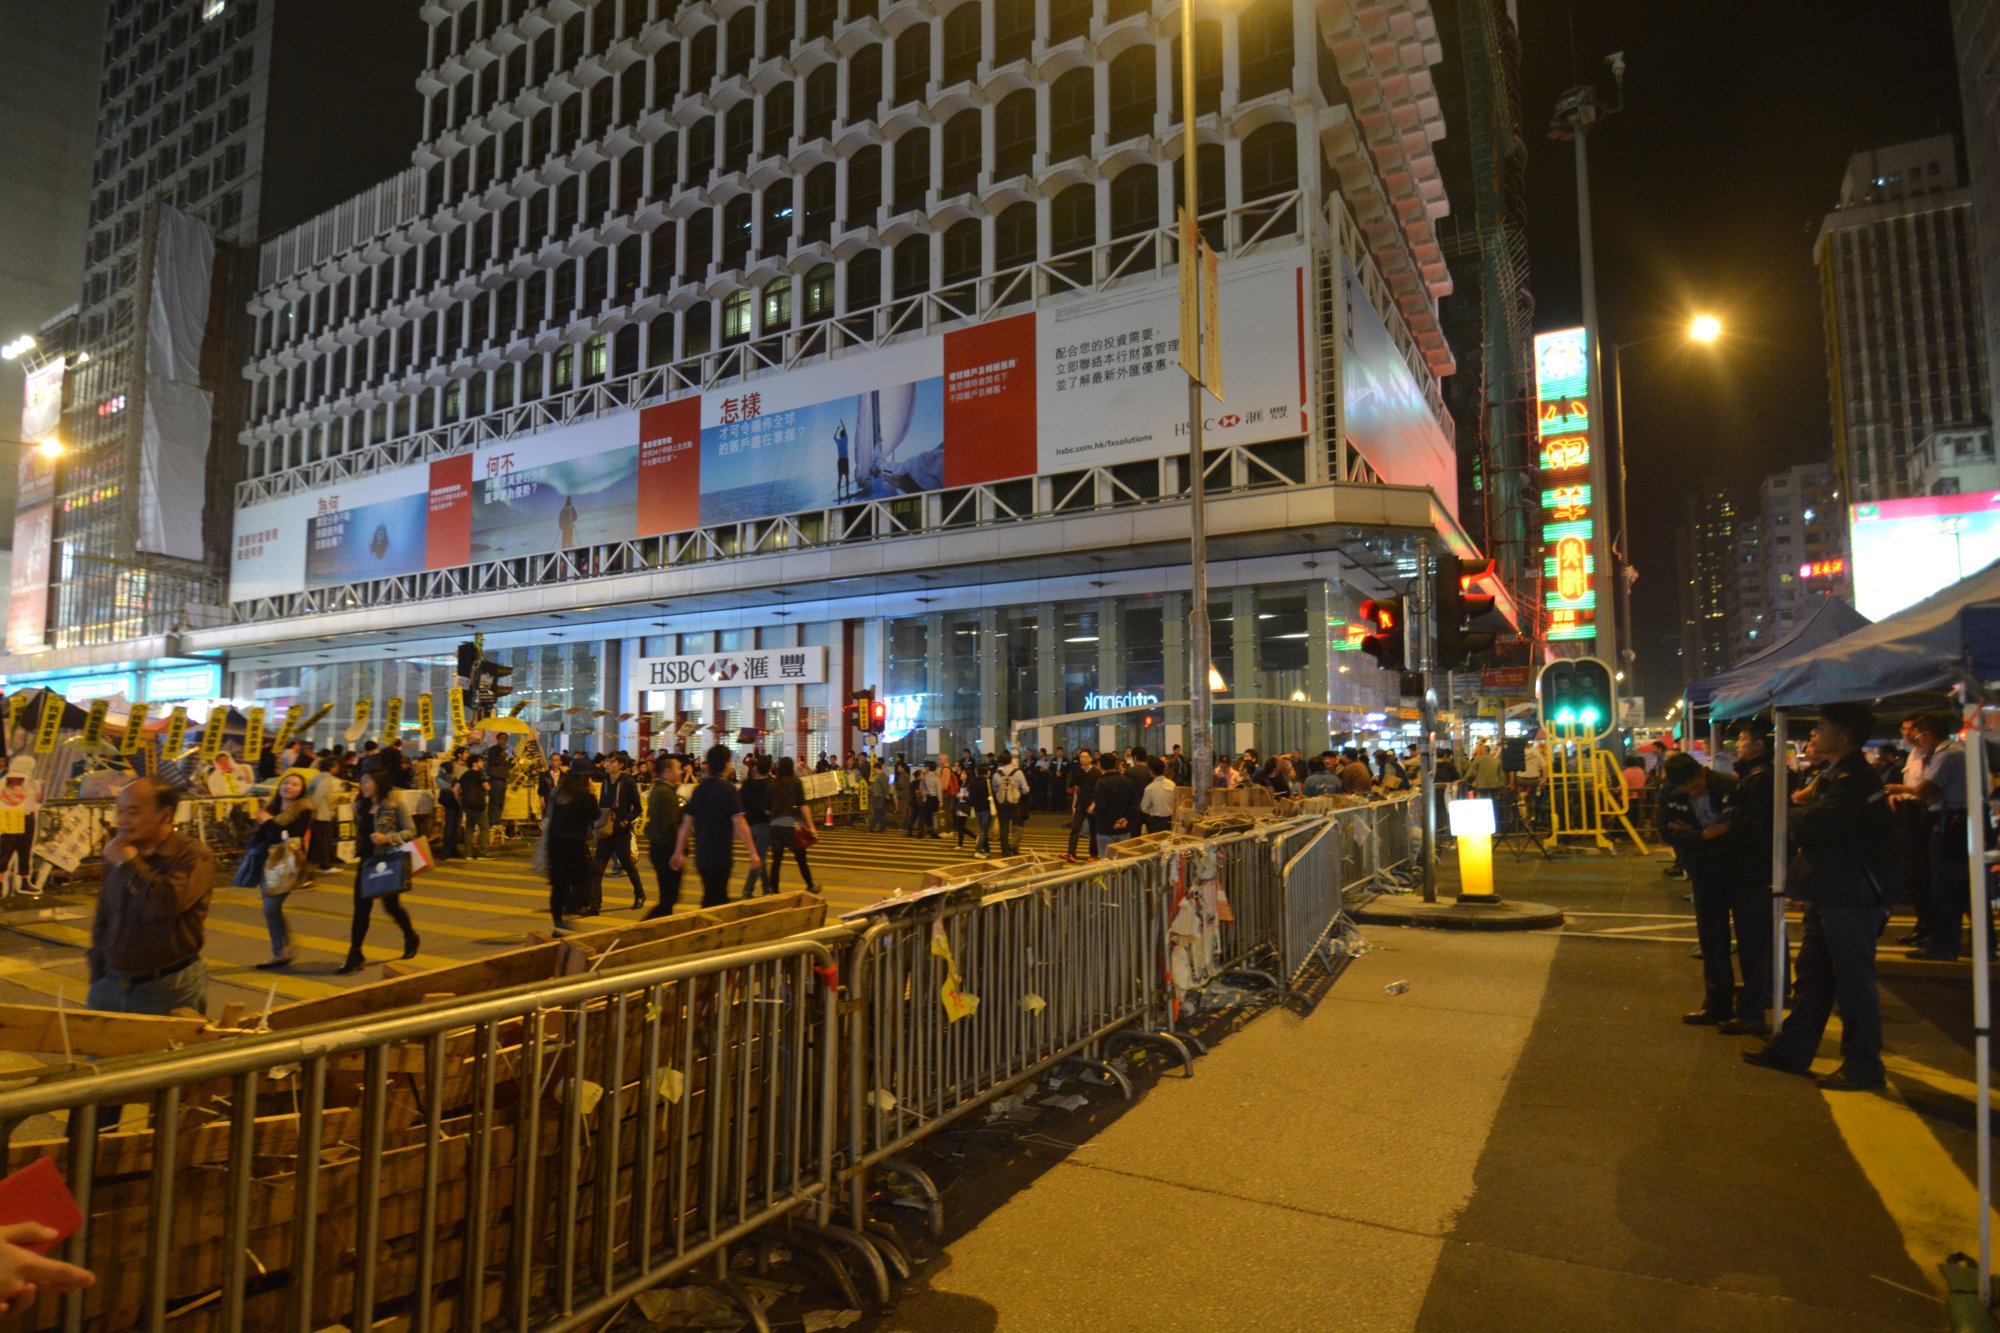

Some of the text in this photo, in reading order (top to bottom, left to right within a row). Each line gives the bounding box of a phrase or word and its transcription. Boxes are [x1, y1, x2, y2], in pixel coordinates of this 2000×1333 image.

[1055, 327, 1160, 360] 配合您的投資需要，
[1055, 335, 1204, 376] 立即聯絡本行財富管理
[1055, 358, 1175, 392] 並了解最新外匯優惠。
[720, 391, 762, 424] 怎樣
[1174, 417, 1215, 437] HSC
[1056, 434, 1153, 456] hsbc.com.hk/fxsolutions
[486, 453, 515, 479] 何不
[650, 659, 705, 685] HSBC
